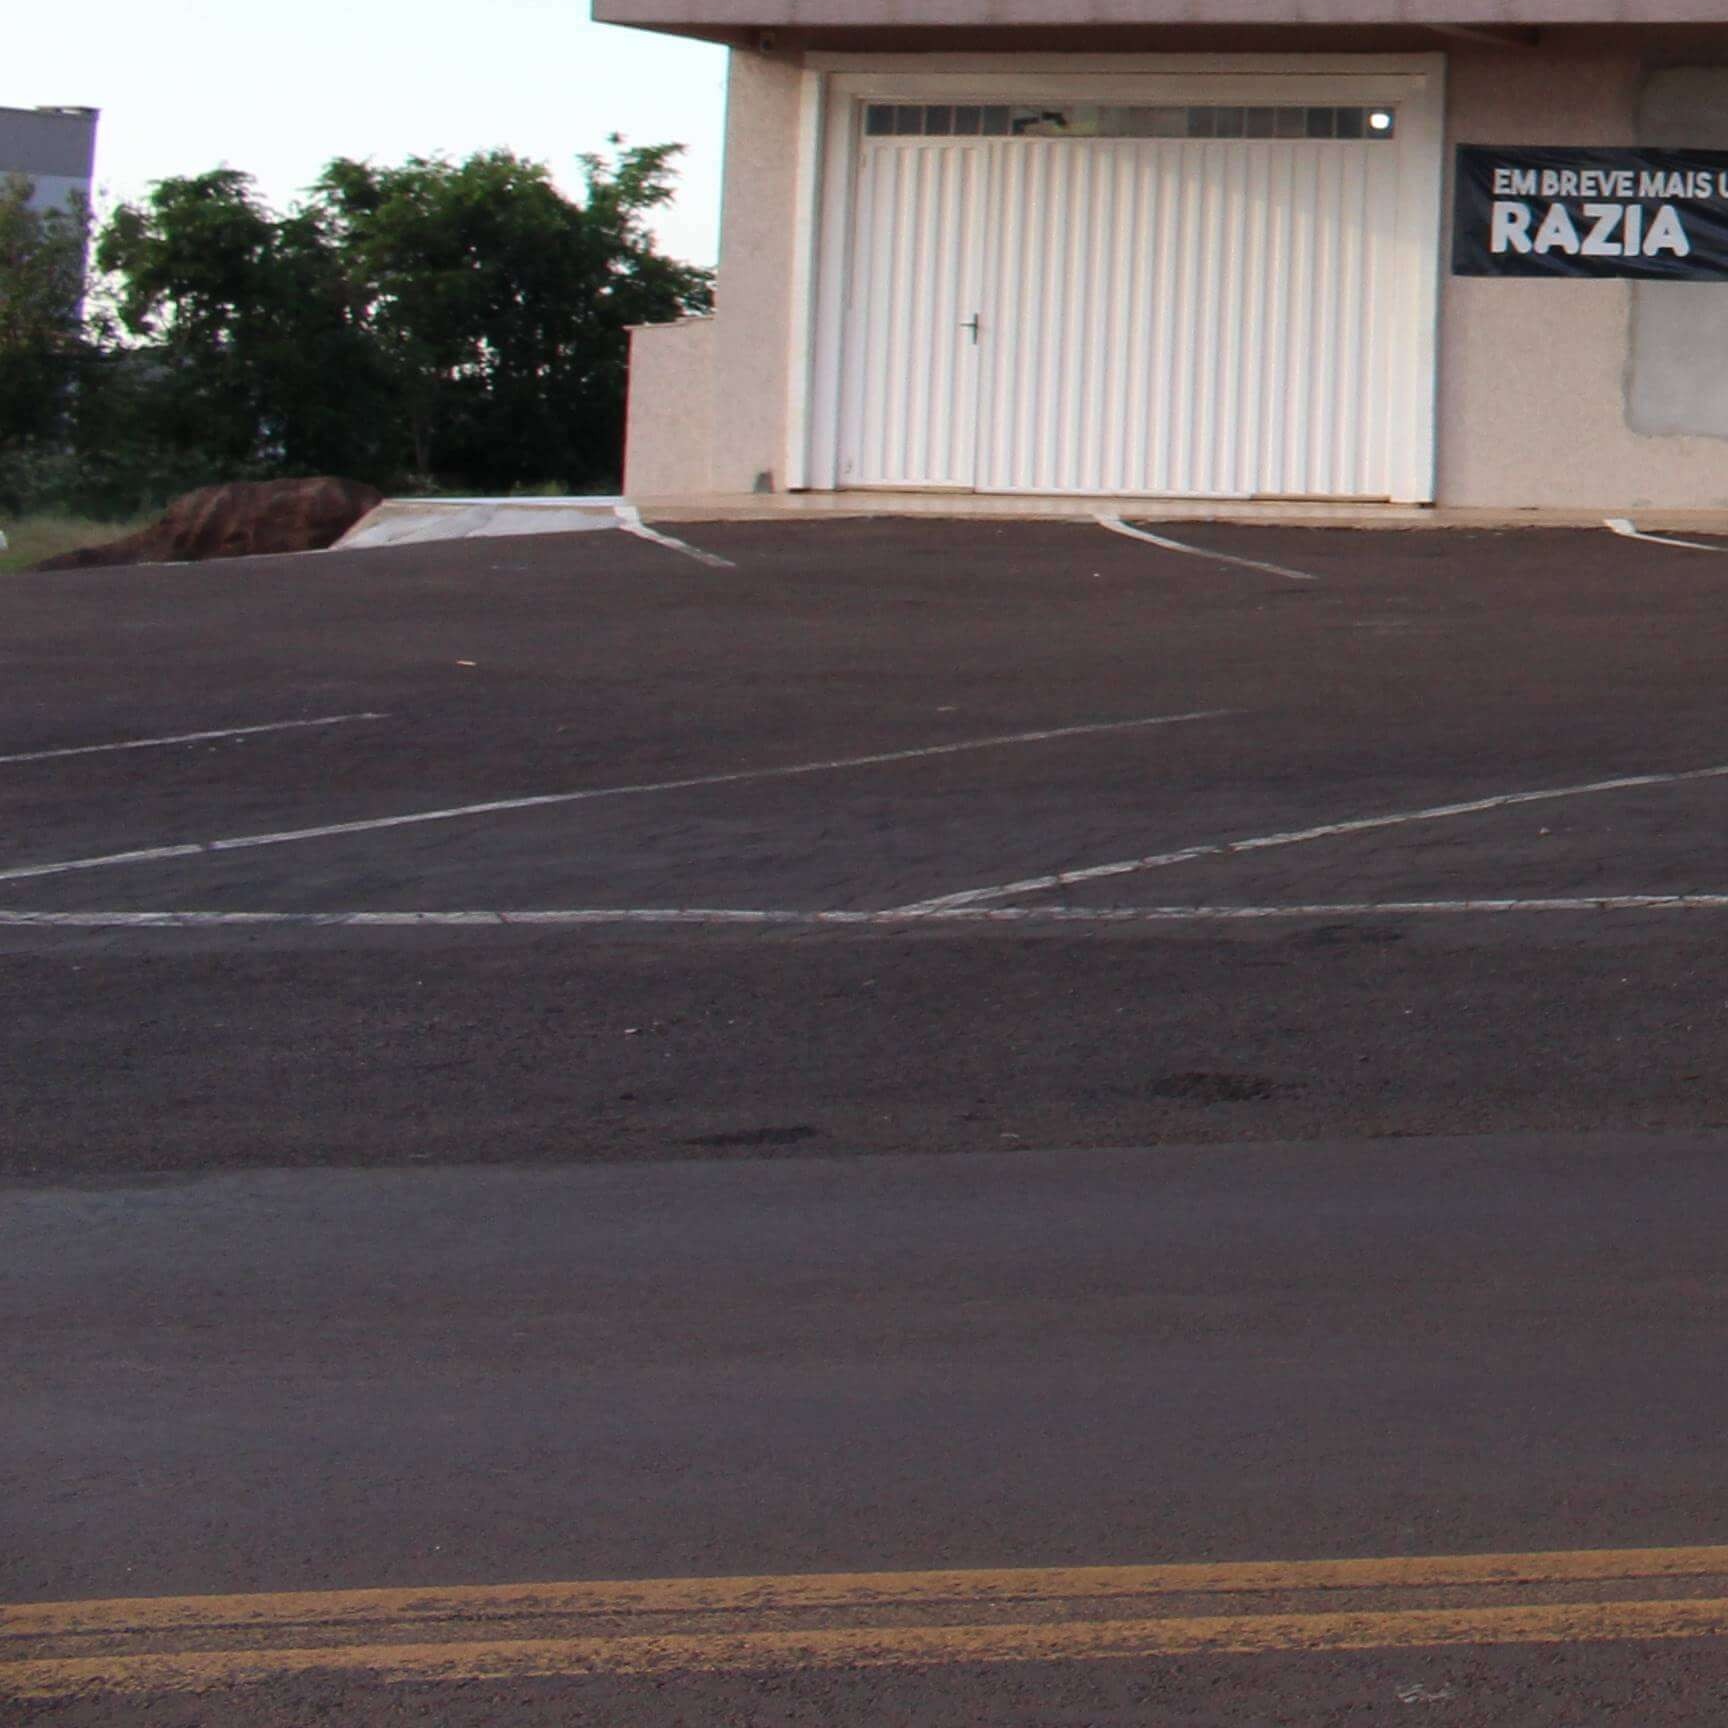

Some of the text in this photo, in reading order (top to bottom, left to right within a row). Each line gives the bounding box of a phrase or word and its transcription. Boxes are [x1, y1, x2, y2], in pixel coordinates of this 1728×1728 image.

[1493, 168, 1537, 196] EM
[1540, 170, 1634, 198] BREVE
[1639, 171, 1711, 199] MAIS
[1490, 201, 1690, 257] RAZIA
